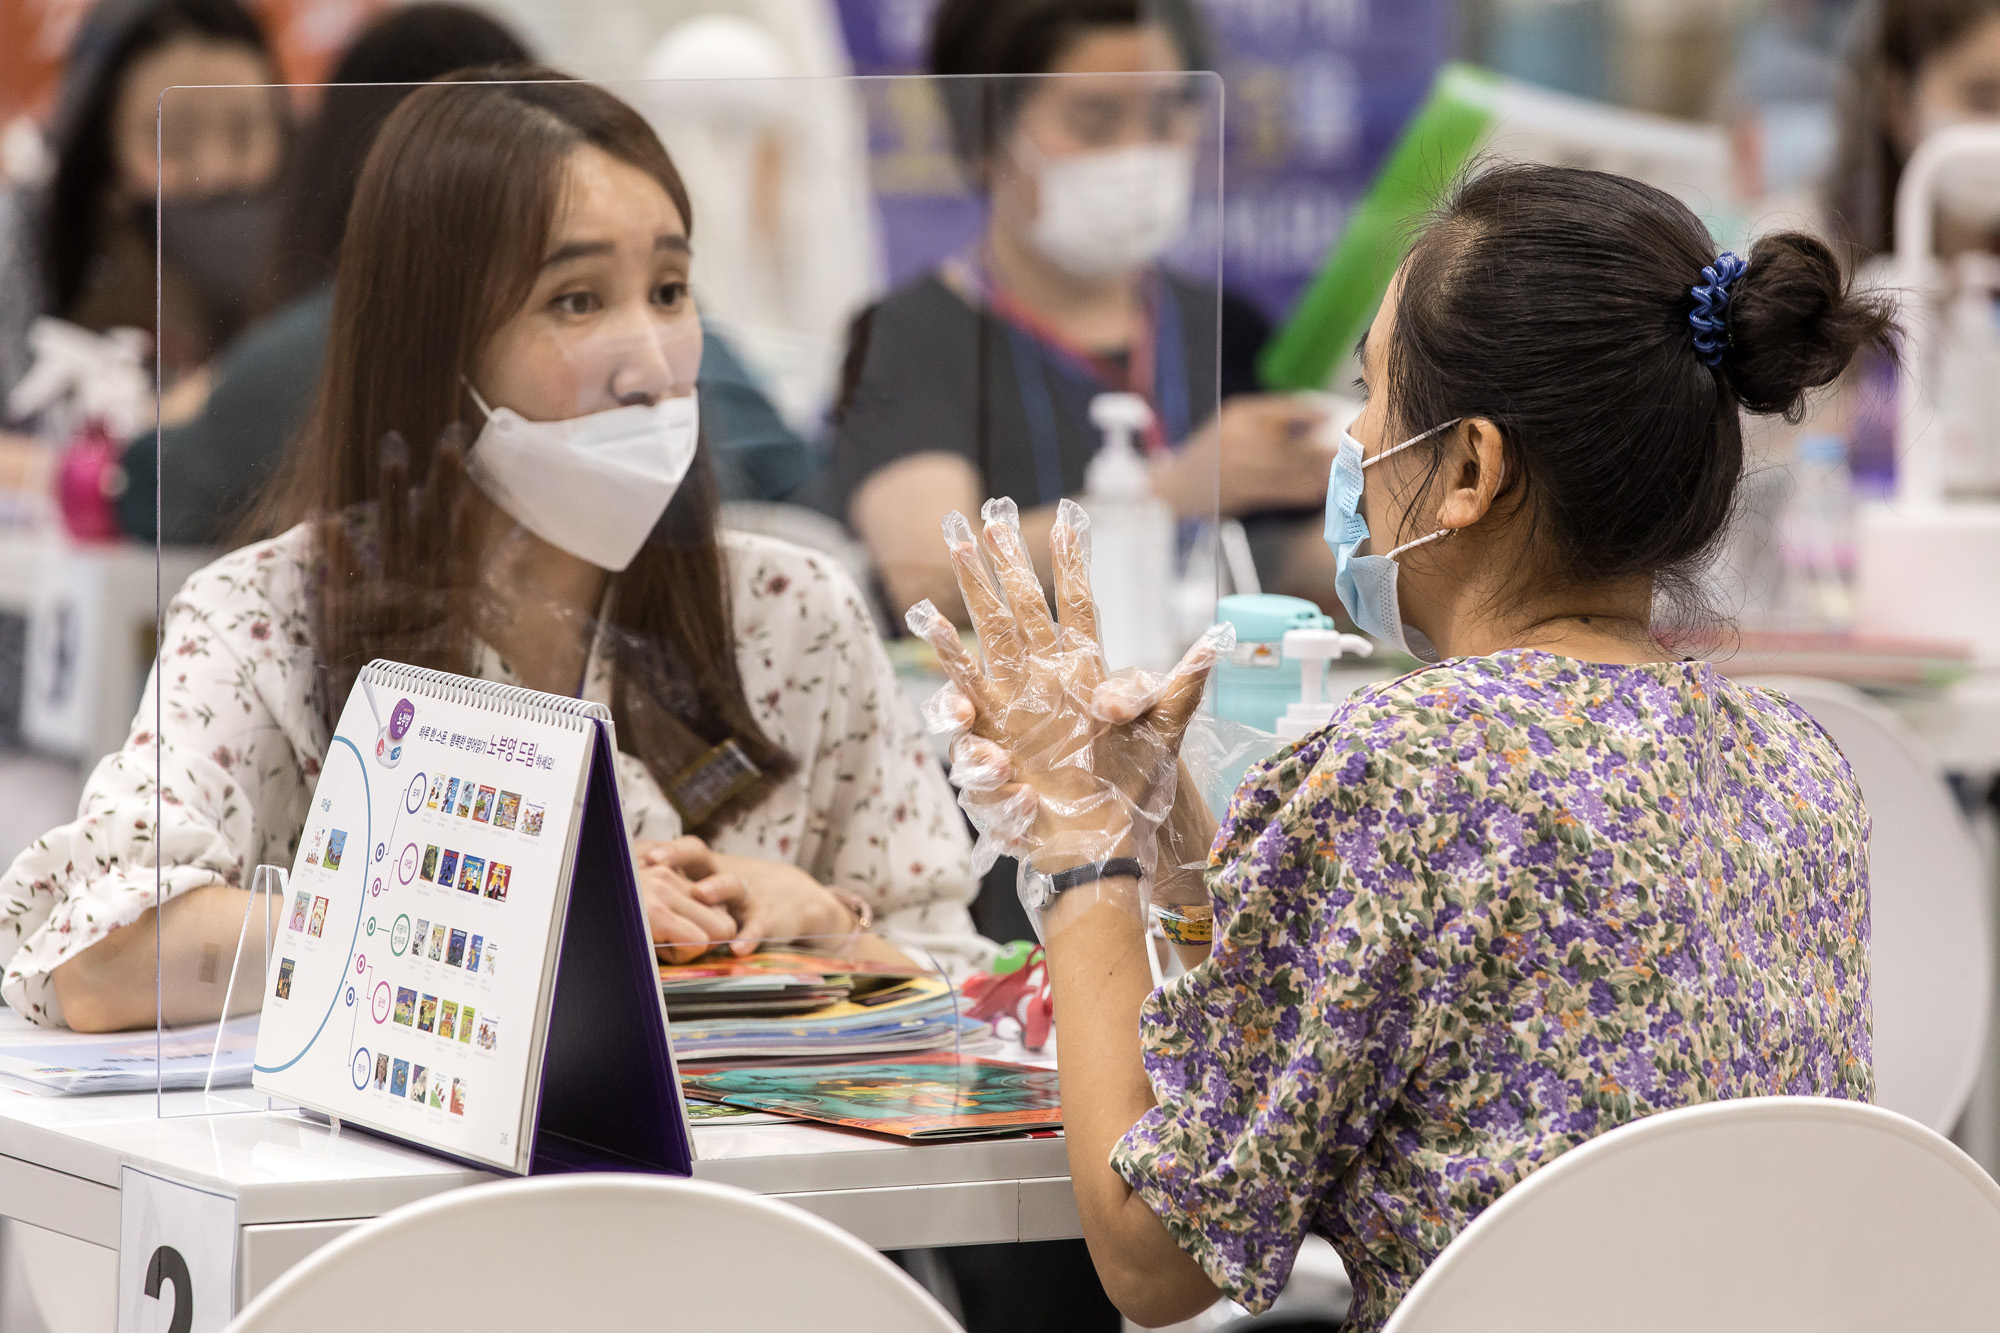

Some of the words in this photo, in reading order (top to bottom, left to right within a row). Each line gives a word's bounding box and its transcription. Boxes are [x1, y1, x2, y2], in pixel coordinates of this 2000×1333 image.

[397, 712, 413, 728] 노부영
[418, 725, 431, 741] 하루
[449, 732, 467, 750] 행복한
[465, 737, 489, 755] 영어읽기
[486, 734, 519, 762] 노부영
[515, 741, 539, 768] 드림
